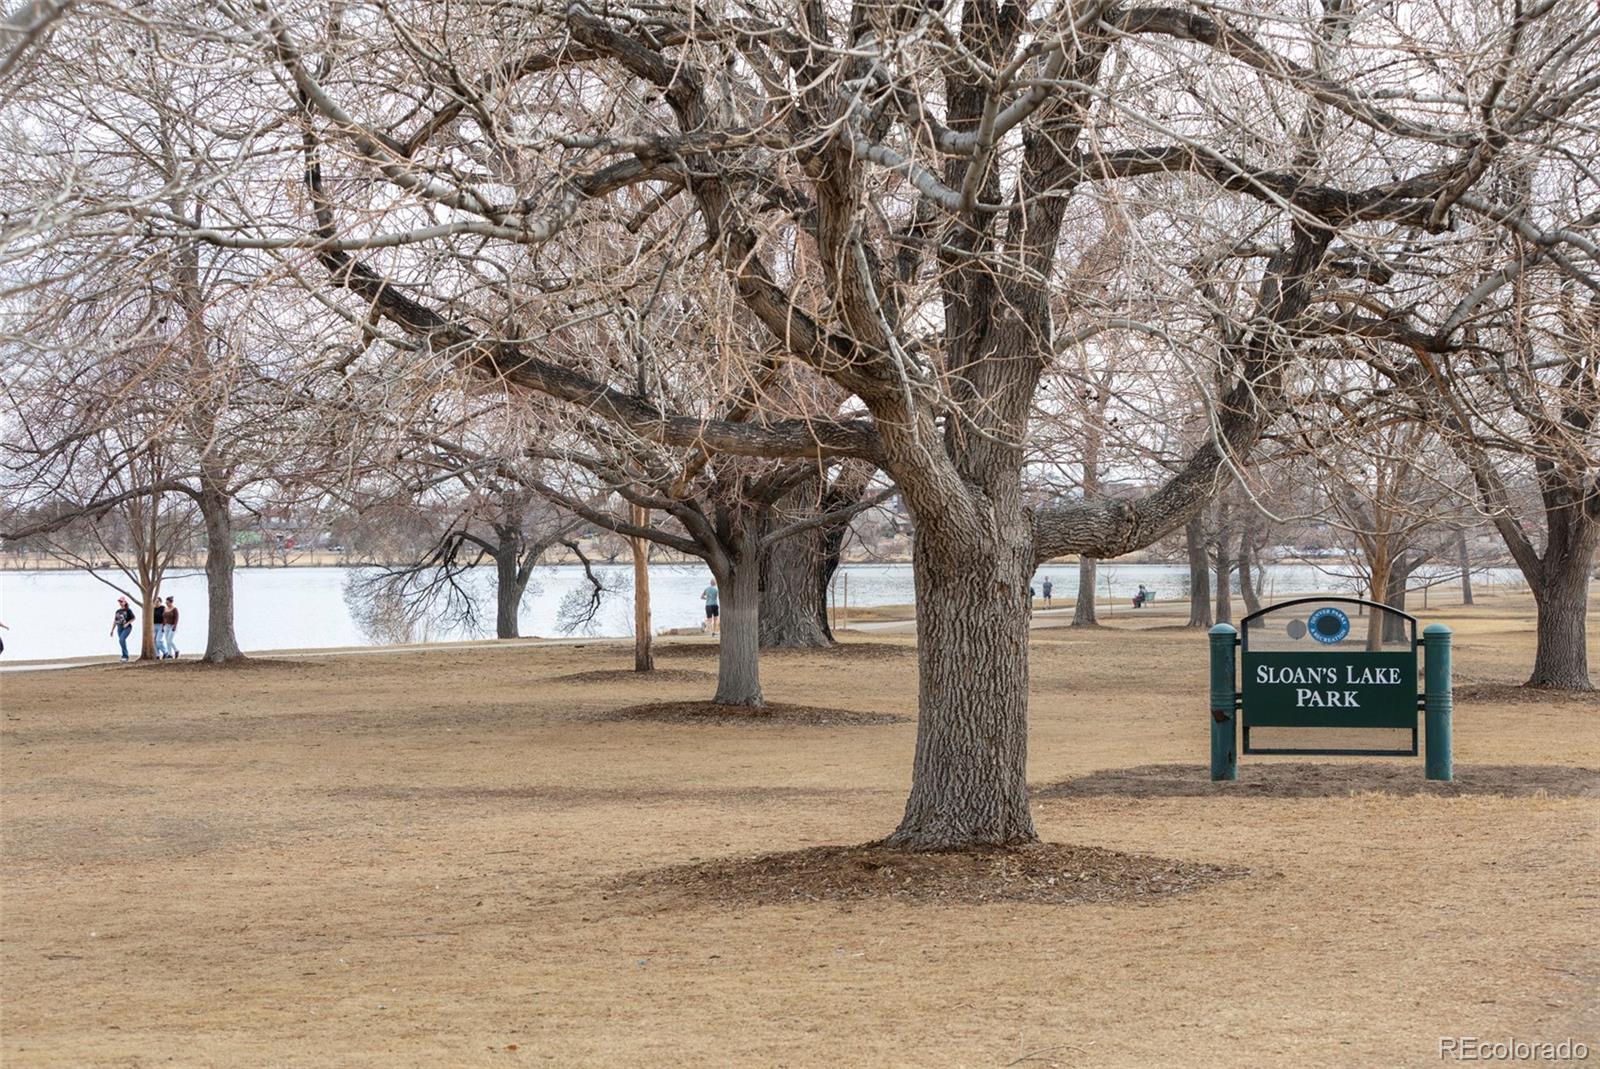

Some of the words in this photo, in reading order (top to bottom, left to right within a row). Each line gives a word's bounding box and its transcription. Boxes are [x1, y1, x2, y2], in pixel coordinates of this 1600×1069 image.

[1256, 664, 1337, 684] SLOAN'S
[1346, 665, 1402, 685] LAKE
[1296, 688, 1360, 707] PARK
